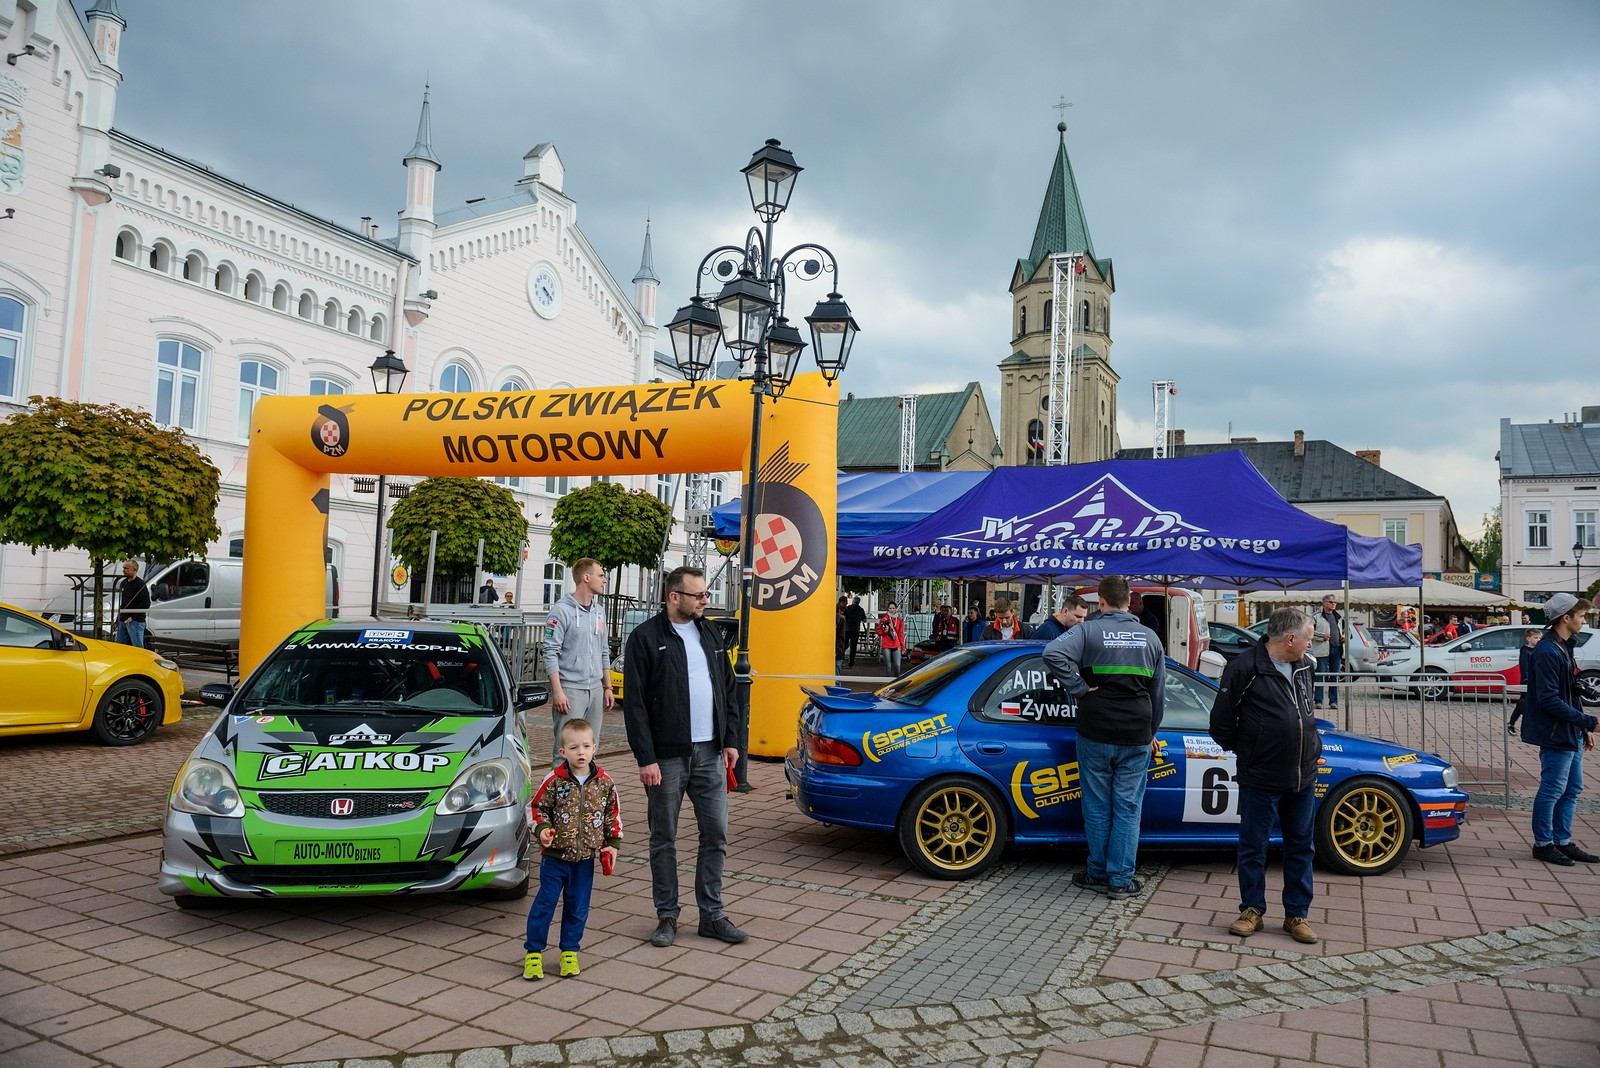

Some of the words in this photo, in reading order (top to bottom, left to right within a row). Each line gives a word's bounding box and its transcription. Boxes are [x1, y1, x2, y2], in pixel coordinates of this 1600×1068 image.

[402, 396, 537, 421] POLSKI
[539, 384, 727, 422] ZWIĄZEK
[322, 444, 346, 457] PZM
[442, 427, 670, 464] MOTOROWY
[872, 542, 982, 560] Wojewódzki
[1070, 538, 1140, 553] Ruchu
[1146, 534, 1281, 554] Drogowego
[1003, 560, 1020, 571] w
[1022, 555, 1106, 571] Krośnie
[757, 562, 820, 607] PZM
[1102, 630, 1147, 641] WRC
[306, 643, 469, 654] WWW.CATKOP.PL
[1021, 694, 1079, 721] Żywar
[332, 734, 389, 742] FINISH
[872, 713, 948, 749] SPORT
[264, 750, 452, 776] CATKOP
[1151, 767, 1177, 781] .com
[293, 842, 355, 860] AUTO-MOTO
[354, 847, 382, 862] BIZNES
